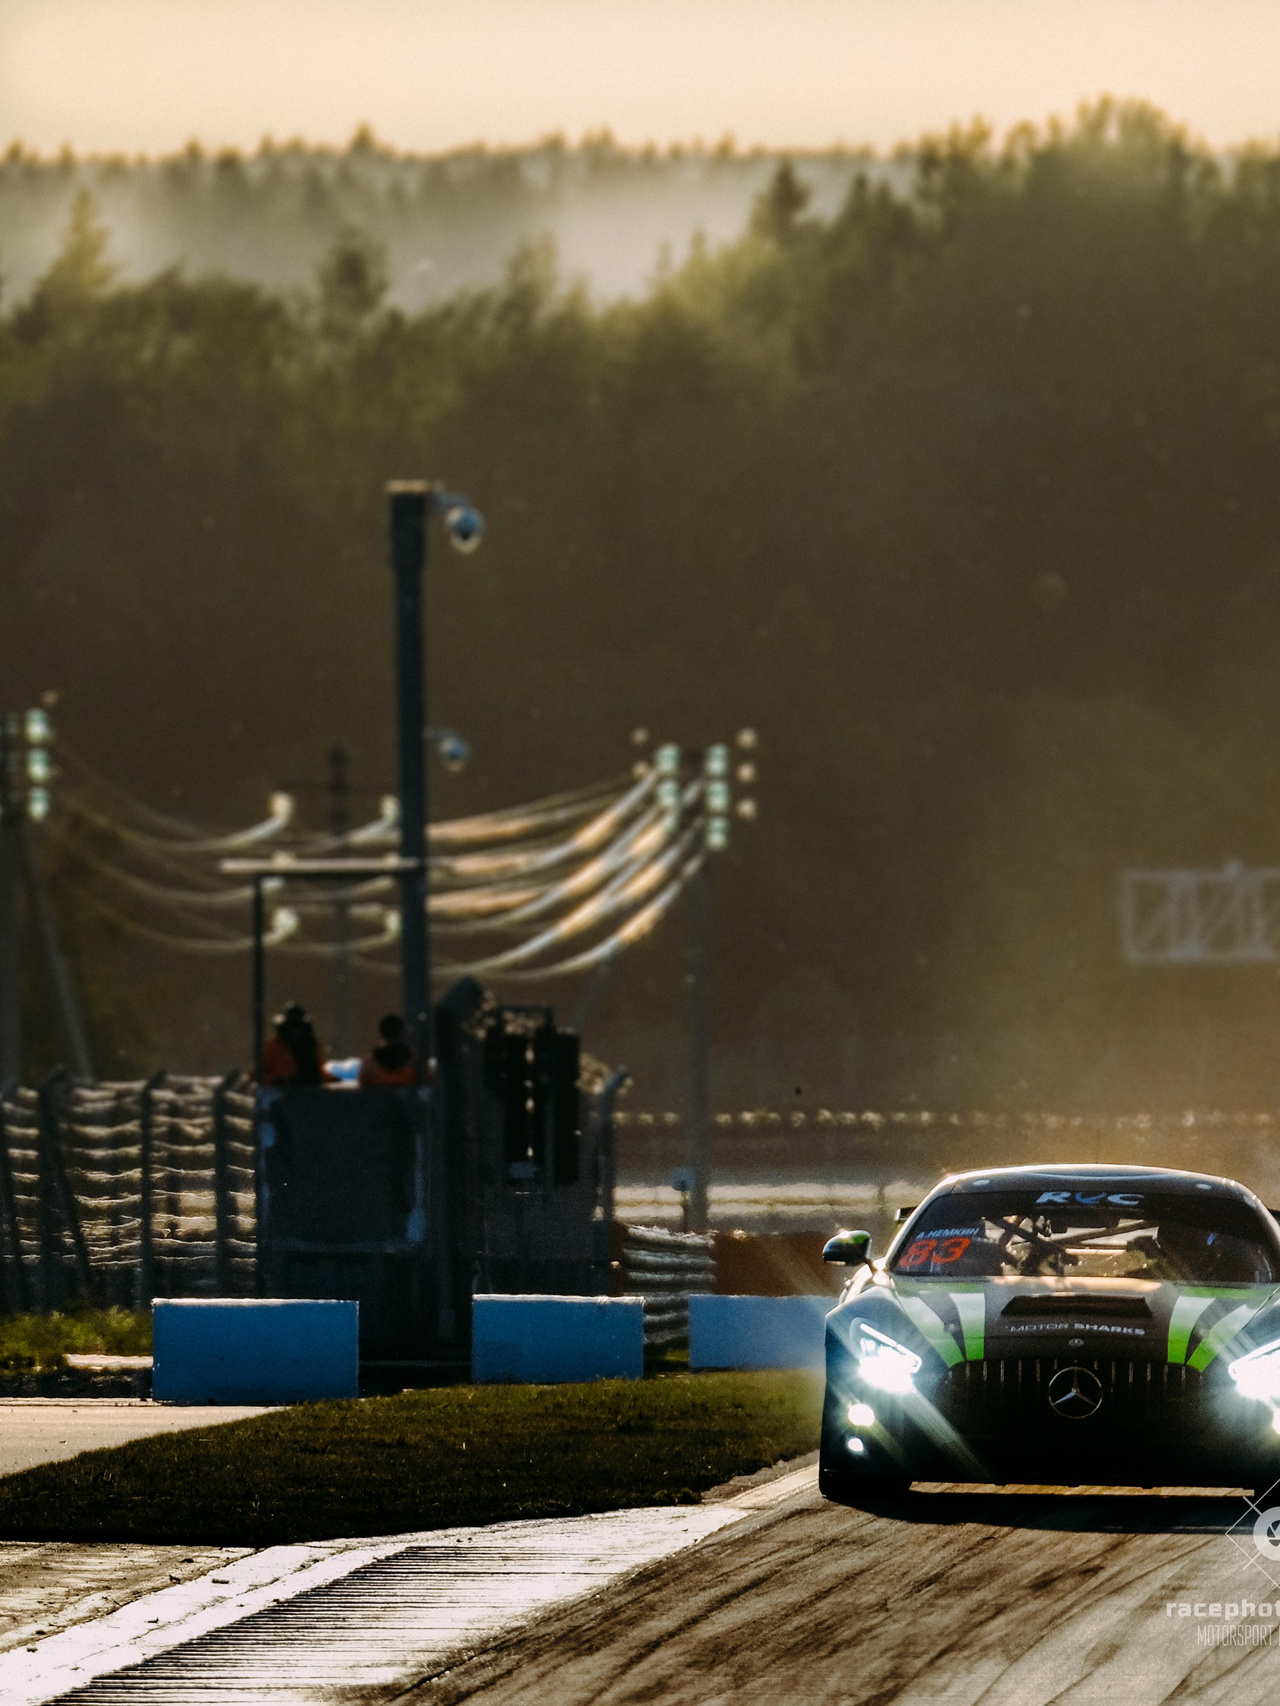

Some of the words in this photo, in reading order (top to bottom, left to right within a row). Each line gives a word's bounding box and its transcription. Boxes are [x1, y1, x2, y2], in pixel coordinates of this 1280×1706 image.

[900, 1237, 970, 1267] 83
[1010, 1323, 1068, 1332] MOTOR
[1074, 1323, 1145, 1335] SHARKS
